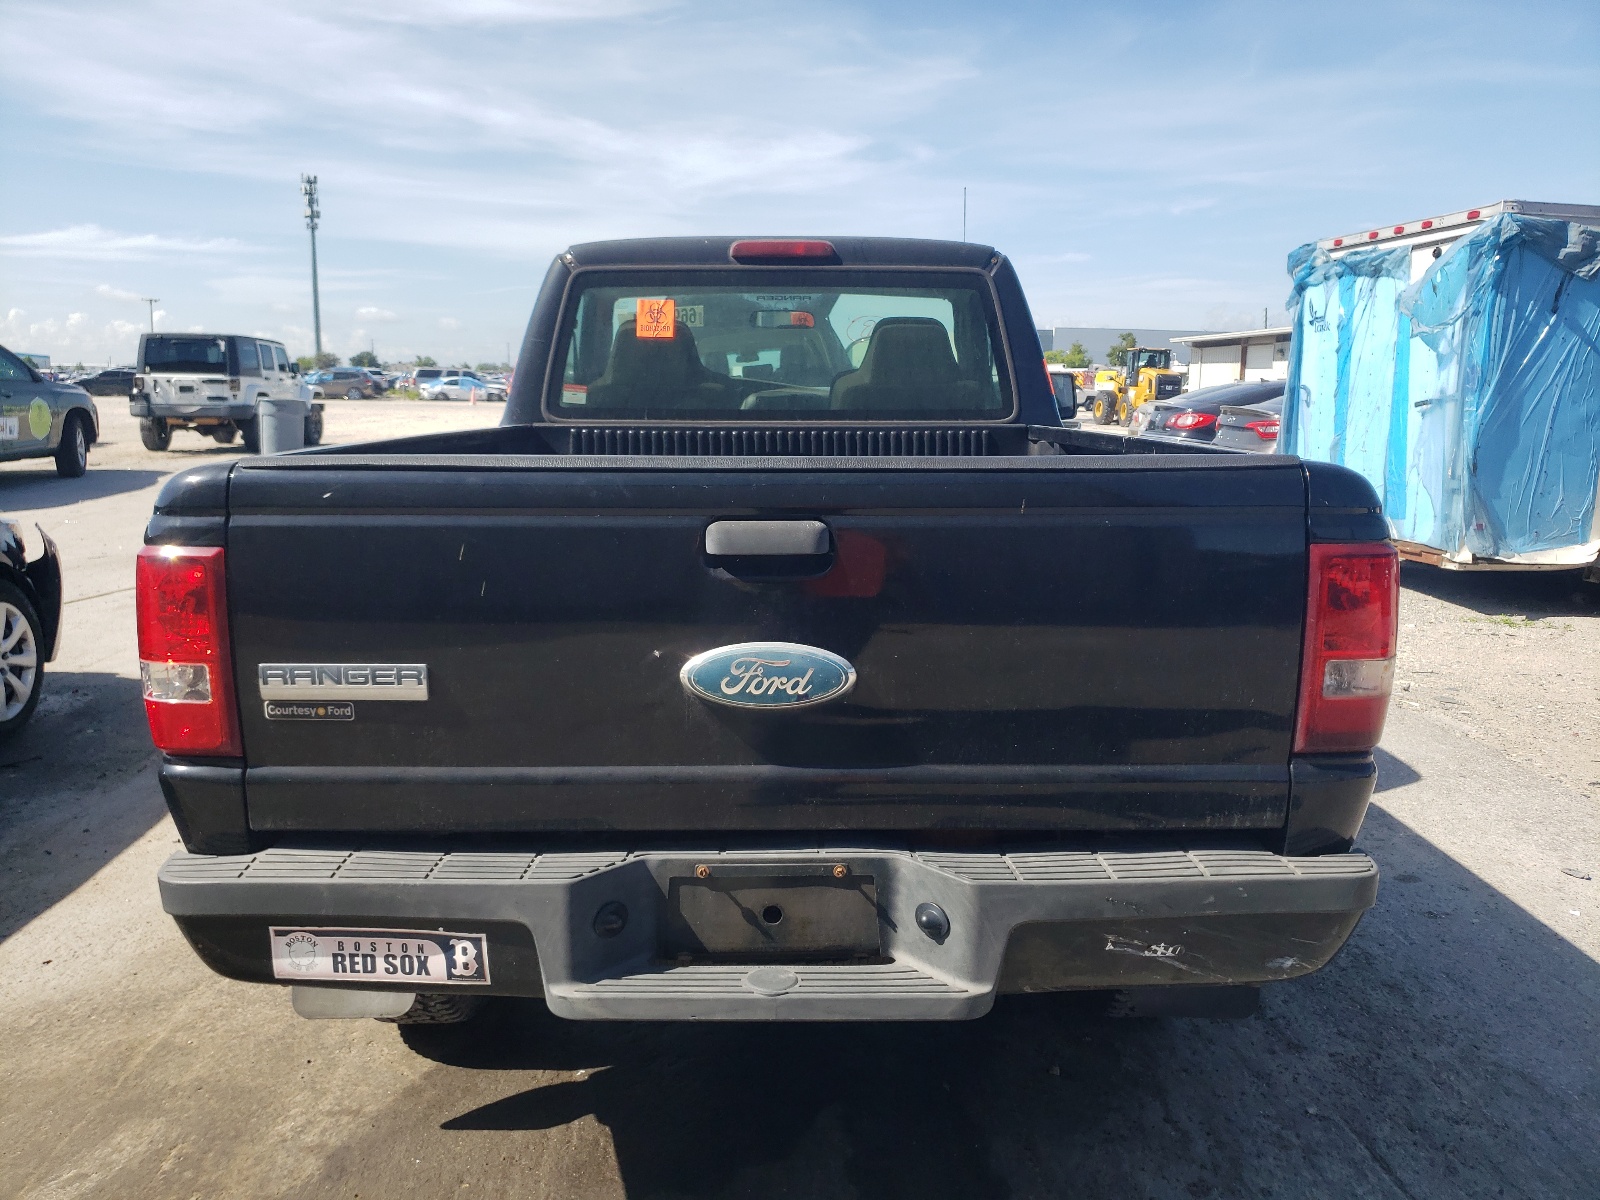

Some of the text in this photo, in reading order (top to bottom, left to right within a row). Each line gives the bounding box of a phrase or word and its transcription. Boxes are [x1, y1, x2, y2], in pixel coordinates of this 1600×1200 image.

[261, 665, 425, 687] RANGER
[720, 657, 815, 695] Ford
[267, 705, 351, 717] Courtesy Ford
[285, 935, 318, 948] BOSTON
[337, 941, 425, 953] BOSTON
[332, 953, 377, 974] RED
[384, 954, 431, 976] SOX
[450, 938, 479, 976] B
